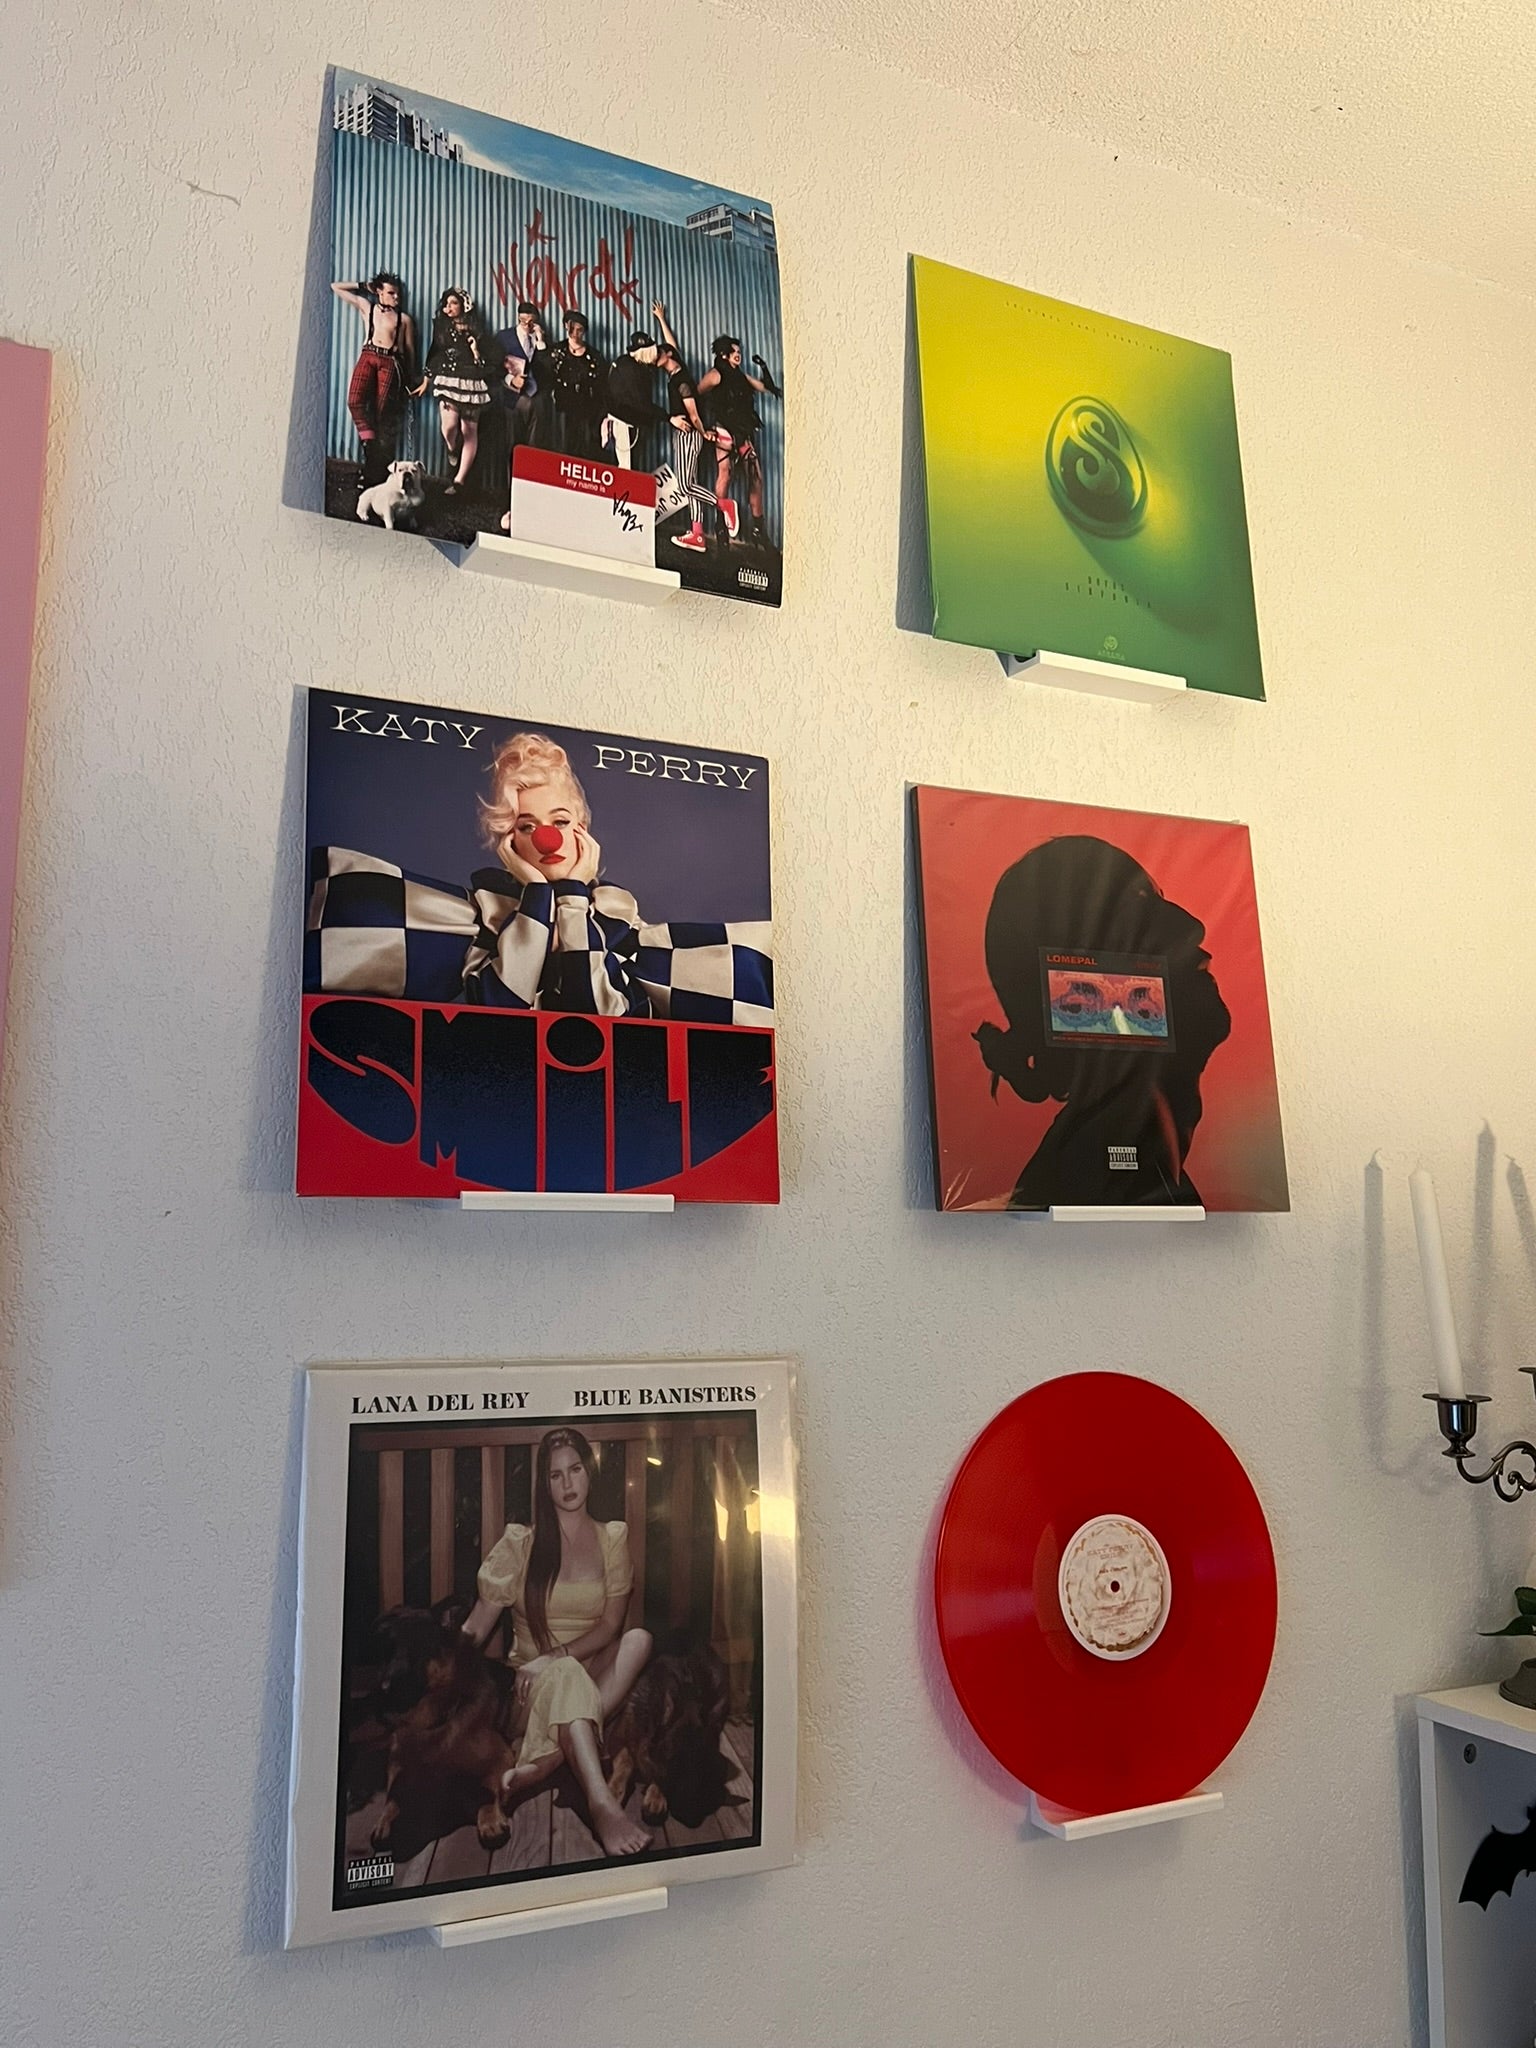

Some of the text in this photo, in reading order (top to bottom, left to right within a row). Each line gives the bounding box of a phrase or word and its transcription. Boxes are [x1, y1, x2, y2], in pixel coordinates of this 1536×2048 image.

[560, 460, 614, 487] HELLO
[330, 704, 758, 791] KATY PERRY
[1046, 953, 1099, 967] LOMEPAL
[352, 1391, 530, 1414] LANA DEL REY
[574, 1386, 757, 1407] BLUE BANISTERS
[349, 1864, 393, 1881] ADVISORY
